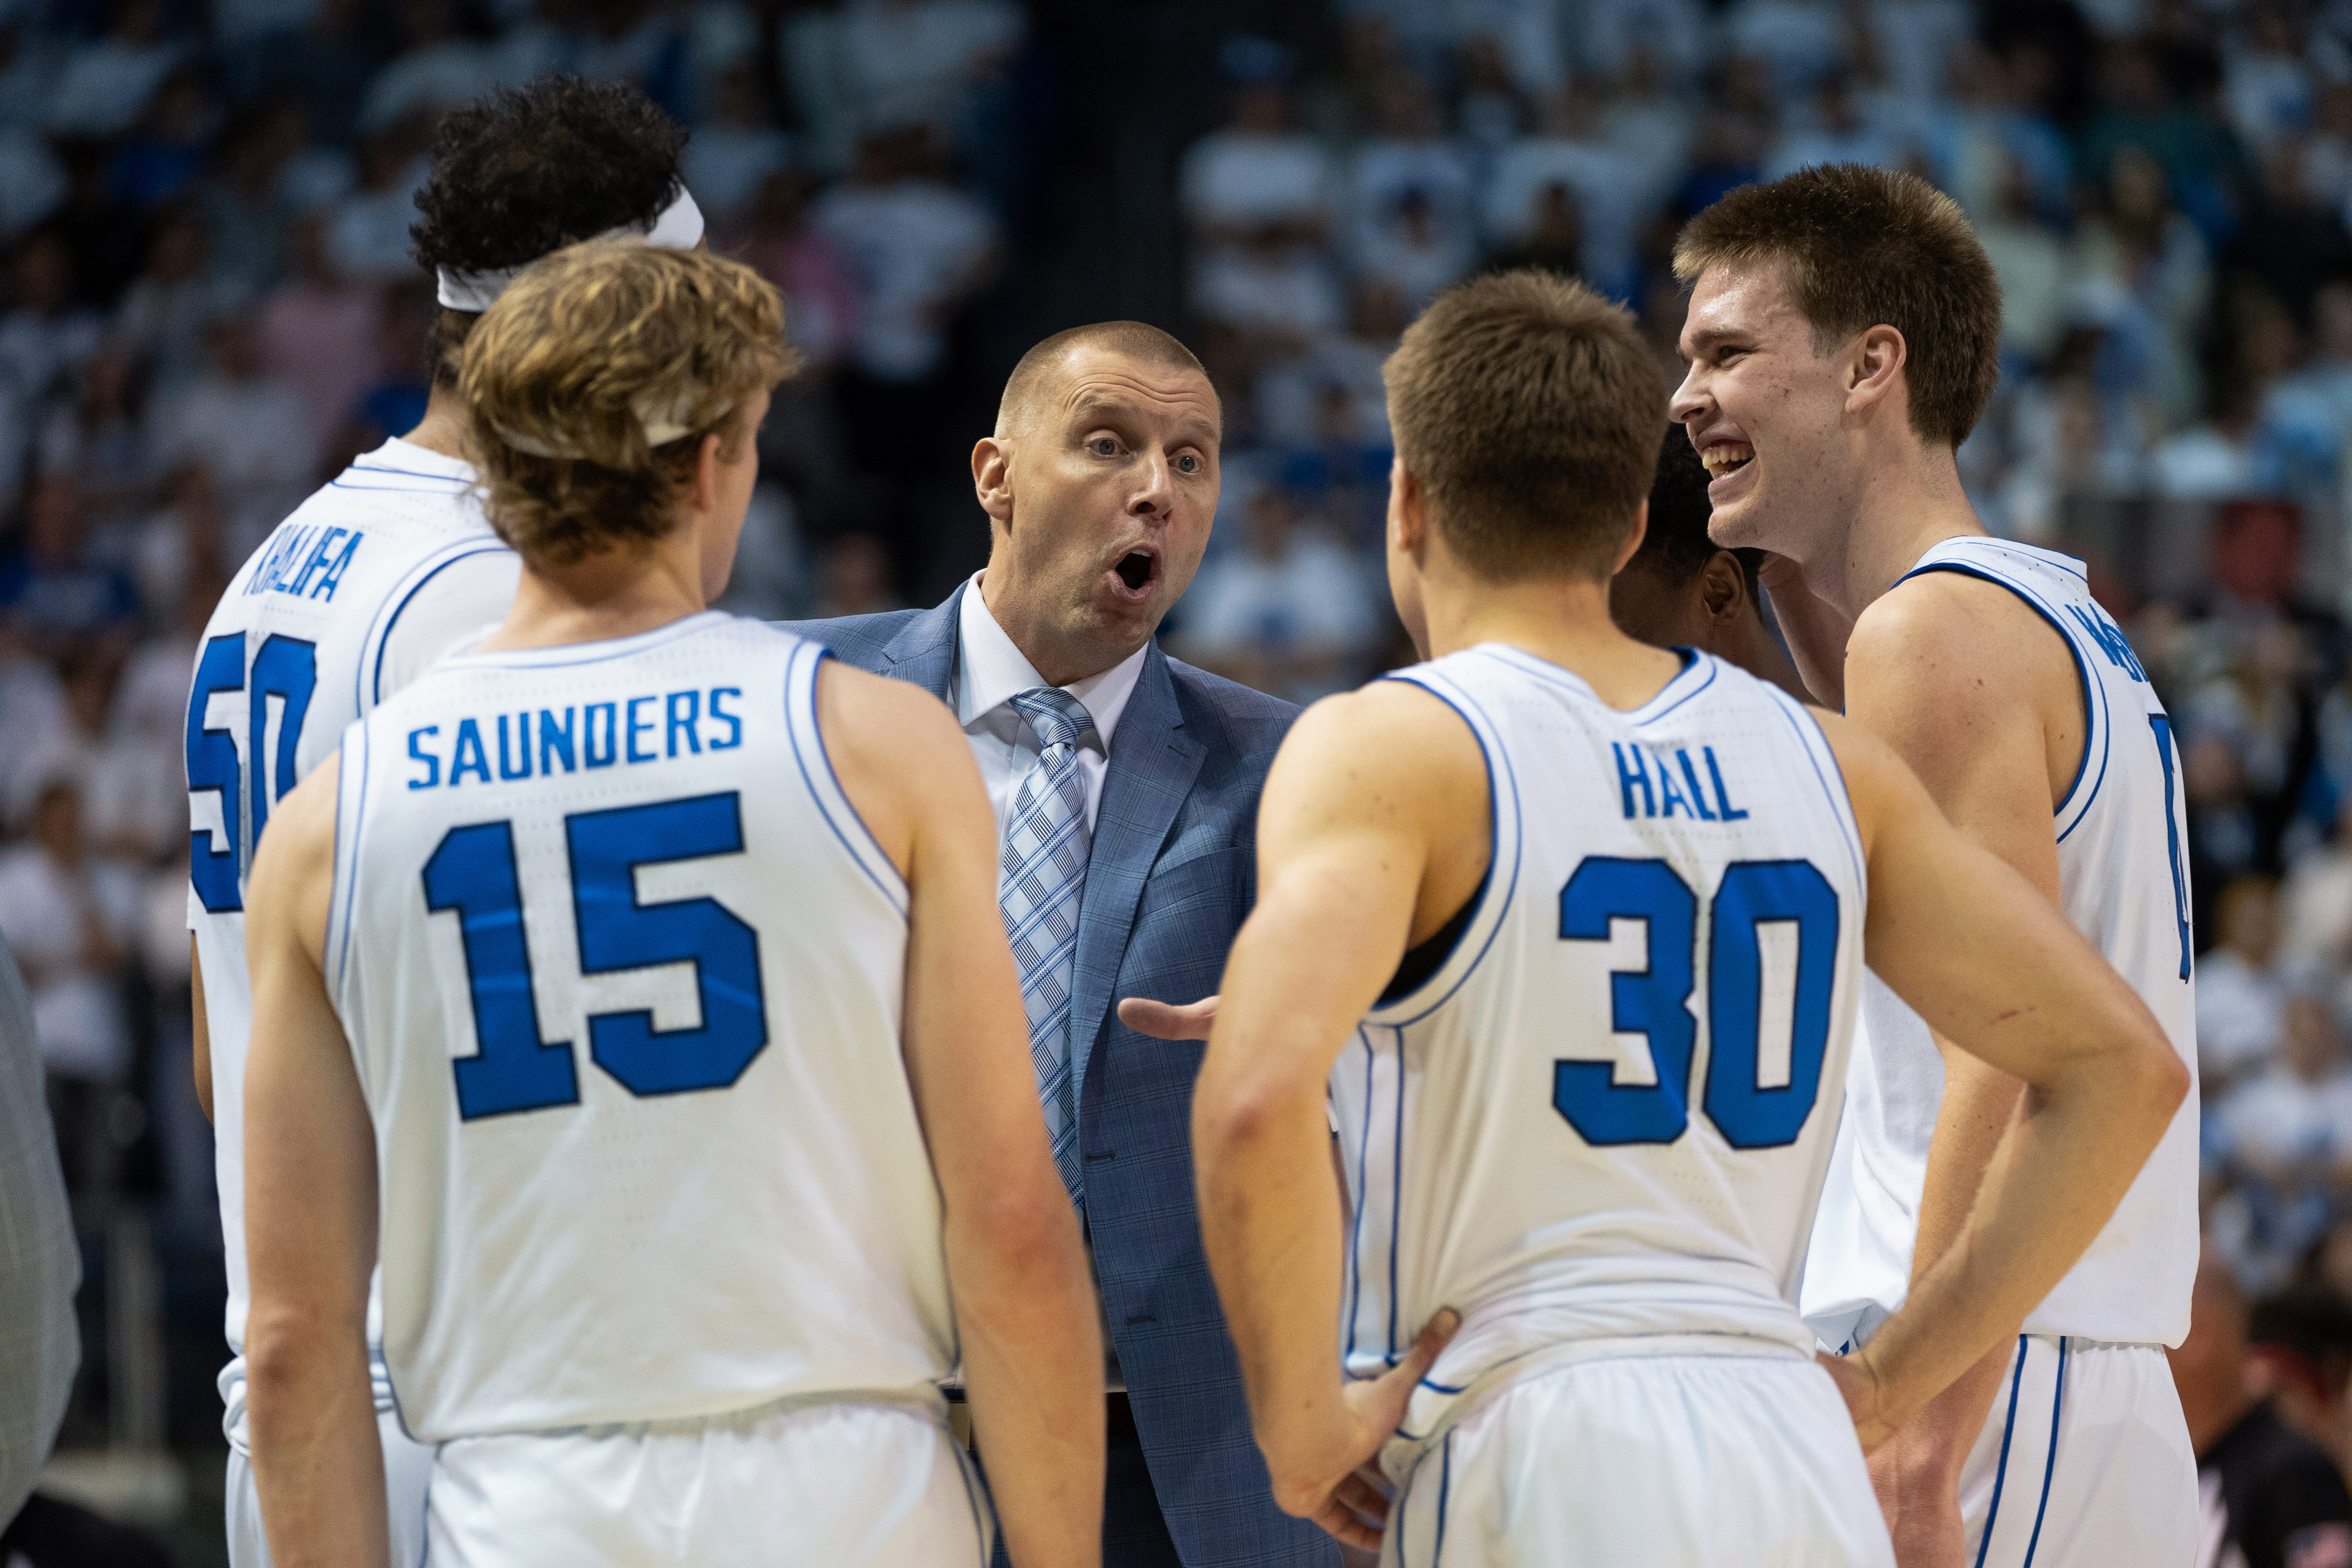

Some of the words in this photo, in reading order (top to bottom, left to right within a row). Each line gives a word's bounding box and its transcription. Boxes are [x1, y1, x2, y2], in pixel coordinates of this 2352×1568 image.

[186, 630, 317, 913] 50
[407, 687, 743, 791] SAUNDERS
[1613, 742, 1749, 822] HALL
[421, 790, 770, 1123] 15
[1552, 855, 1840, 1151] 30
